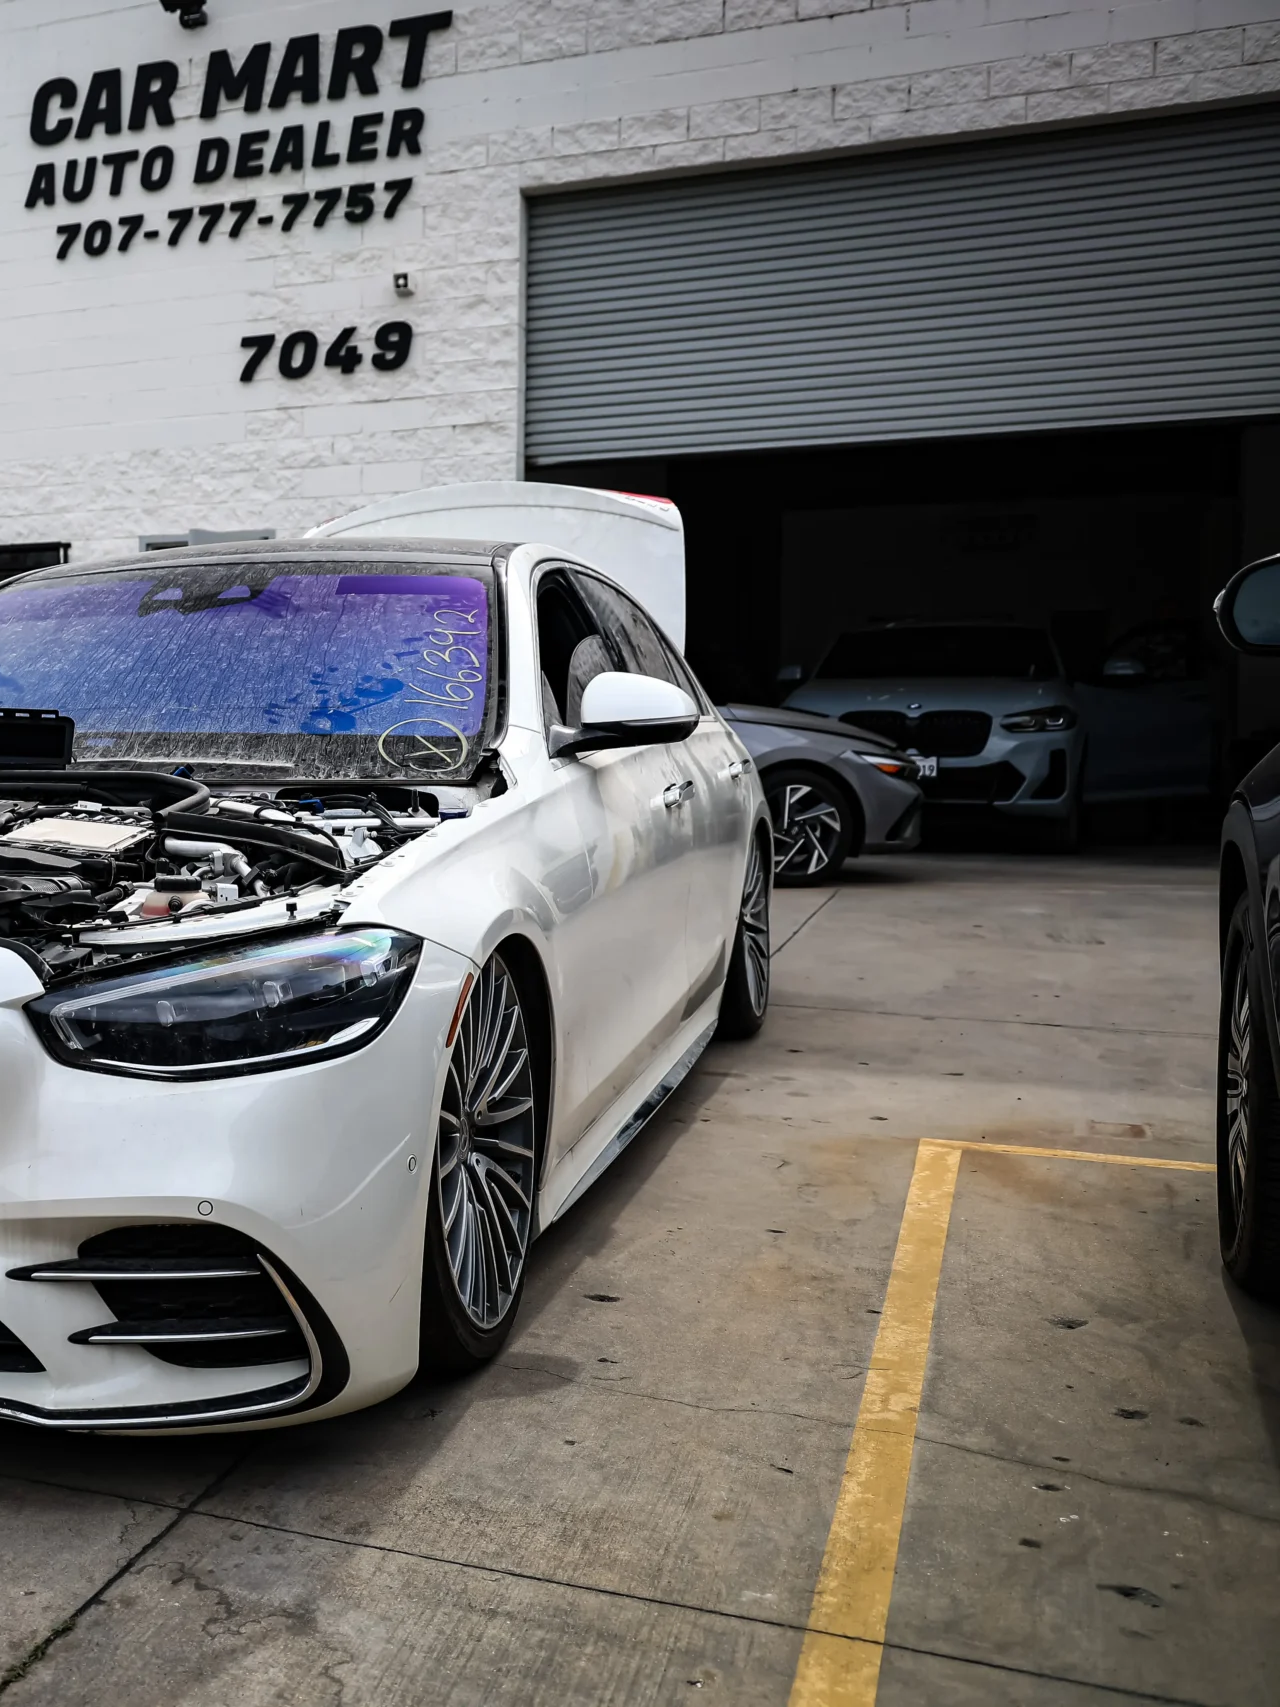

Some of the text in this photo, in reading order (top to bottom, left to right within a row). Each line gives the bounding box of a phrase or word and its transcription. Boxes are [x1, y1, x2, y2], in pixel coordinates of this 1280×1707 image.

[29, 10, 453, 146] CAR MART
[24, 107, 425, 208] AUTO DEALER
[55, 178, 413, 260] 707-777-7757
[240, 320, 413, 382] 7049
[404, 609, 482, 710] 166392
